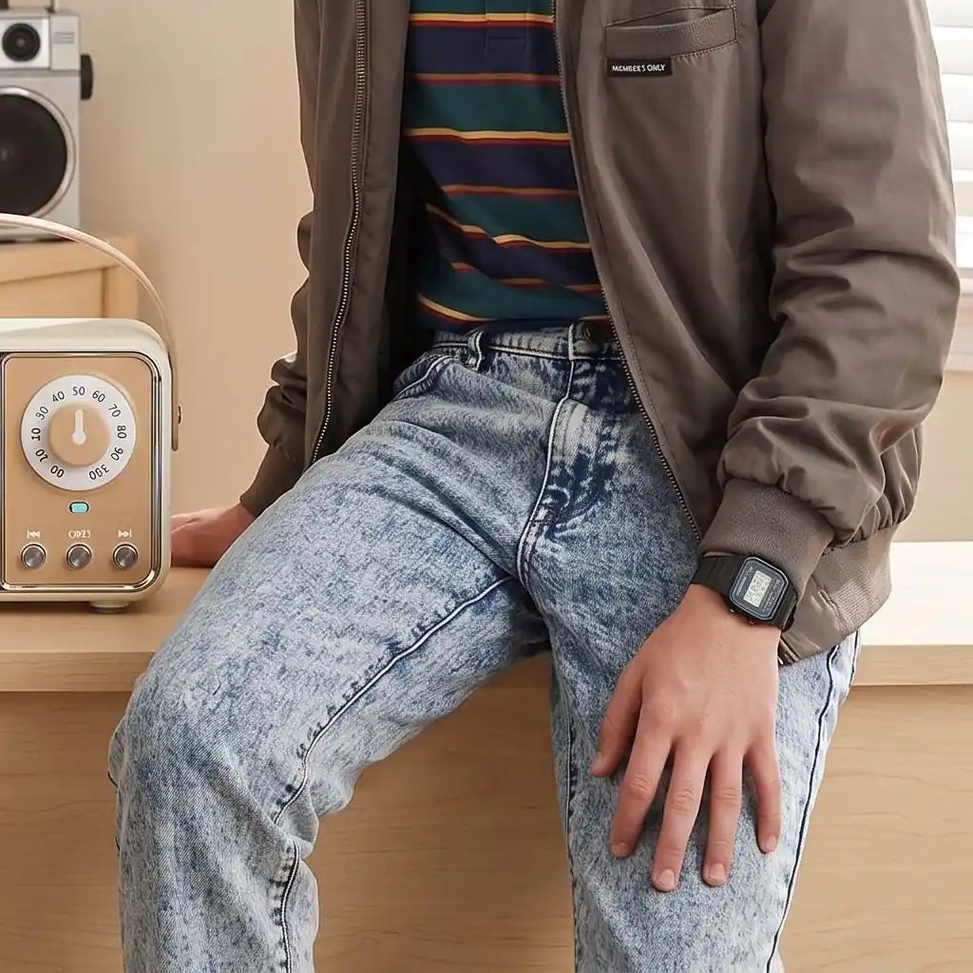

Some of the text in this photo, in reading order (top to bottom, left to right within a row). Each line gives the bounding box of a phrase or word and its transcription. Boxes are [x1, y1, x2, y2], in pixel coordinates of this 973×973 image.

[52, 390, 65, 402] 40
[72, 386, 85, 396] 50
[92, 390, 106, 403] 60
[108, 403, 121, 418] 70
[117, 425, 127, 439] 80
